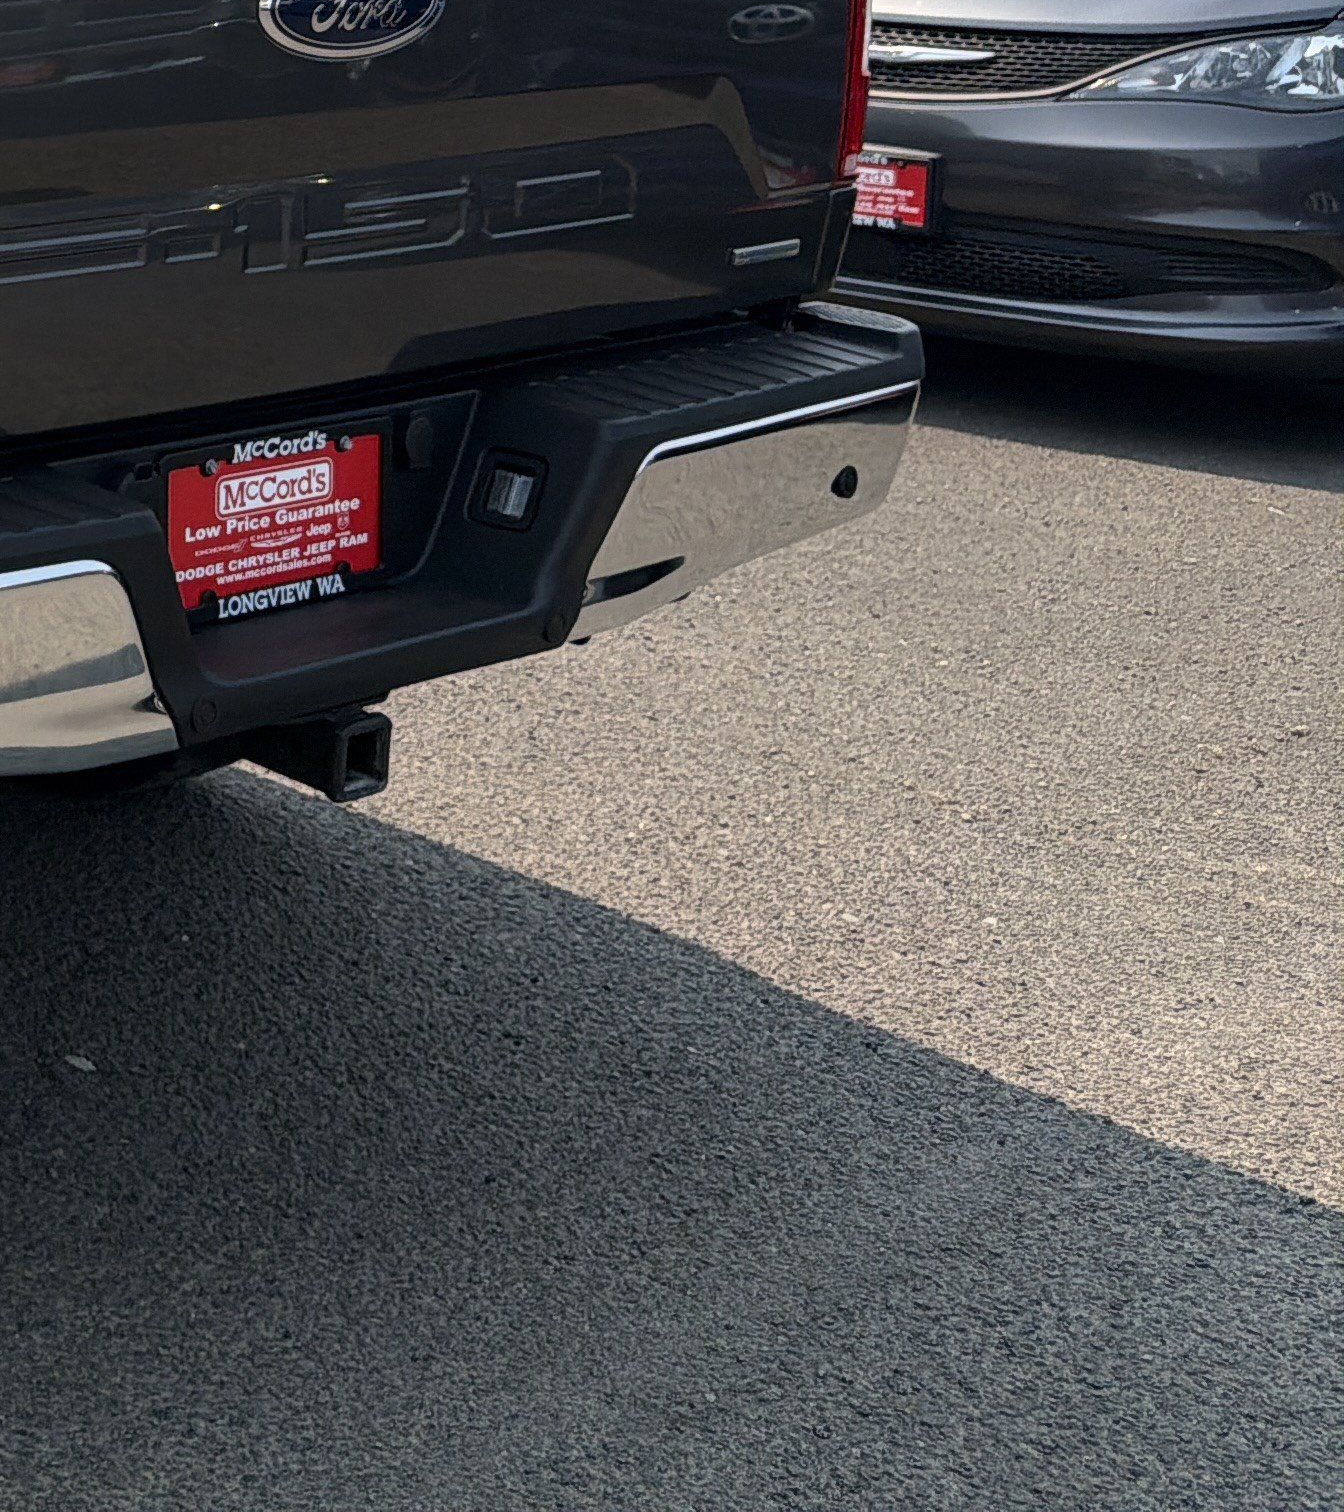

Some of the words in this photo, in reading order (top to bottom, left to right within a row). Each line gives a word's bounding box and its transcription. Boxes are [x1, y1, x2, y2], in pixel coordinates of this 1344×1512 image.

[232, 430, 327, 464] McCord's
[223, 468, 326, 511] McCord's
[184, 525, 221, 543] Low
[226, 515, 270, 535] Price
[275, 497, 361, 526] Guarantee
[306, 521, 332, 537] Jeep
[175, 561, 224, 583] DODGE
[228, 546, 300, 572] CHRYSLER
[303, 539, 336, 557] JEEP
[339, 532, 369, 549] RAM
[215, 553, 332, 586] www.mccordsales.com
[218, 579, 312, 619] LONGVIEW
[316, 572, 345, 597] WA
